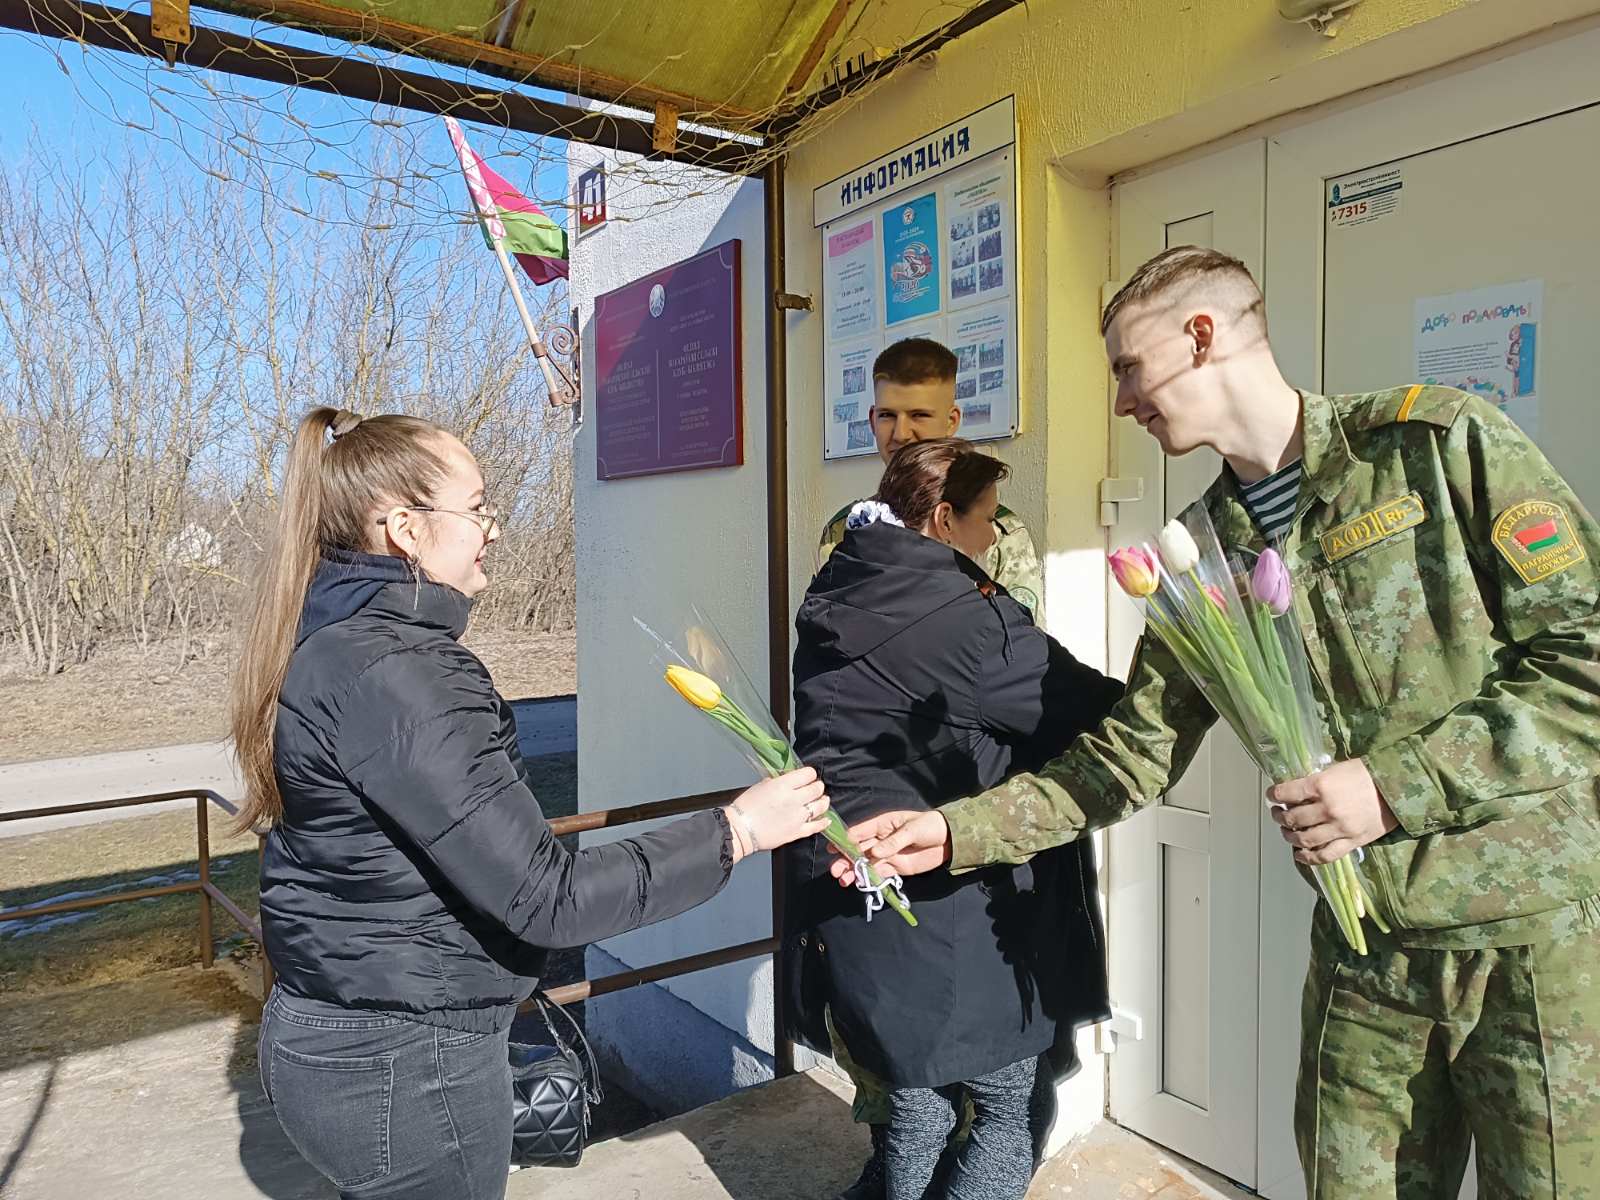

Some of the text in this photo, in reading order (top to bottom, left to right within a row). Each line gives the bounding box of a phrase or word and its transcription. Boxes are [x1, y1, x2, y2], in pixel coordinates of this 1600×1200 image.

[841, 126, 970, 207] ИНФОРМАЦИЯ
[1338, 202, 1367, 220] 7315
[1421, 312, 1456, 333] ДОБРО
[1500, 504, 1555, 538] БЕЛАРУСЬ
